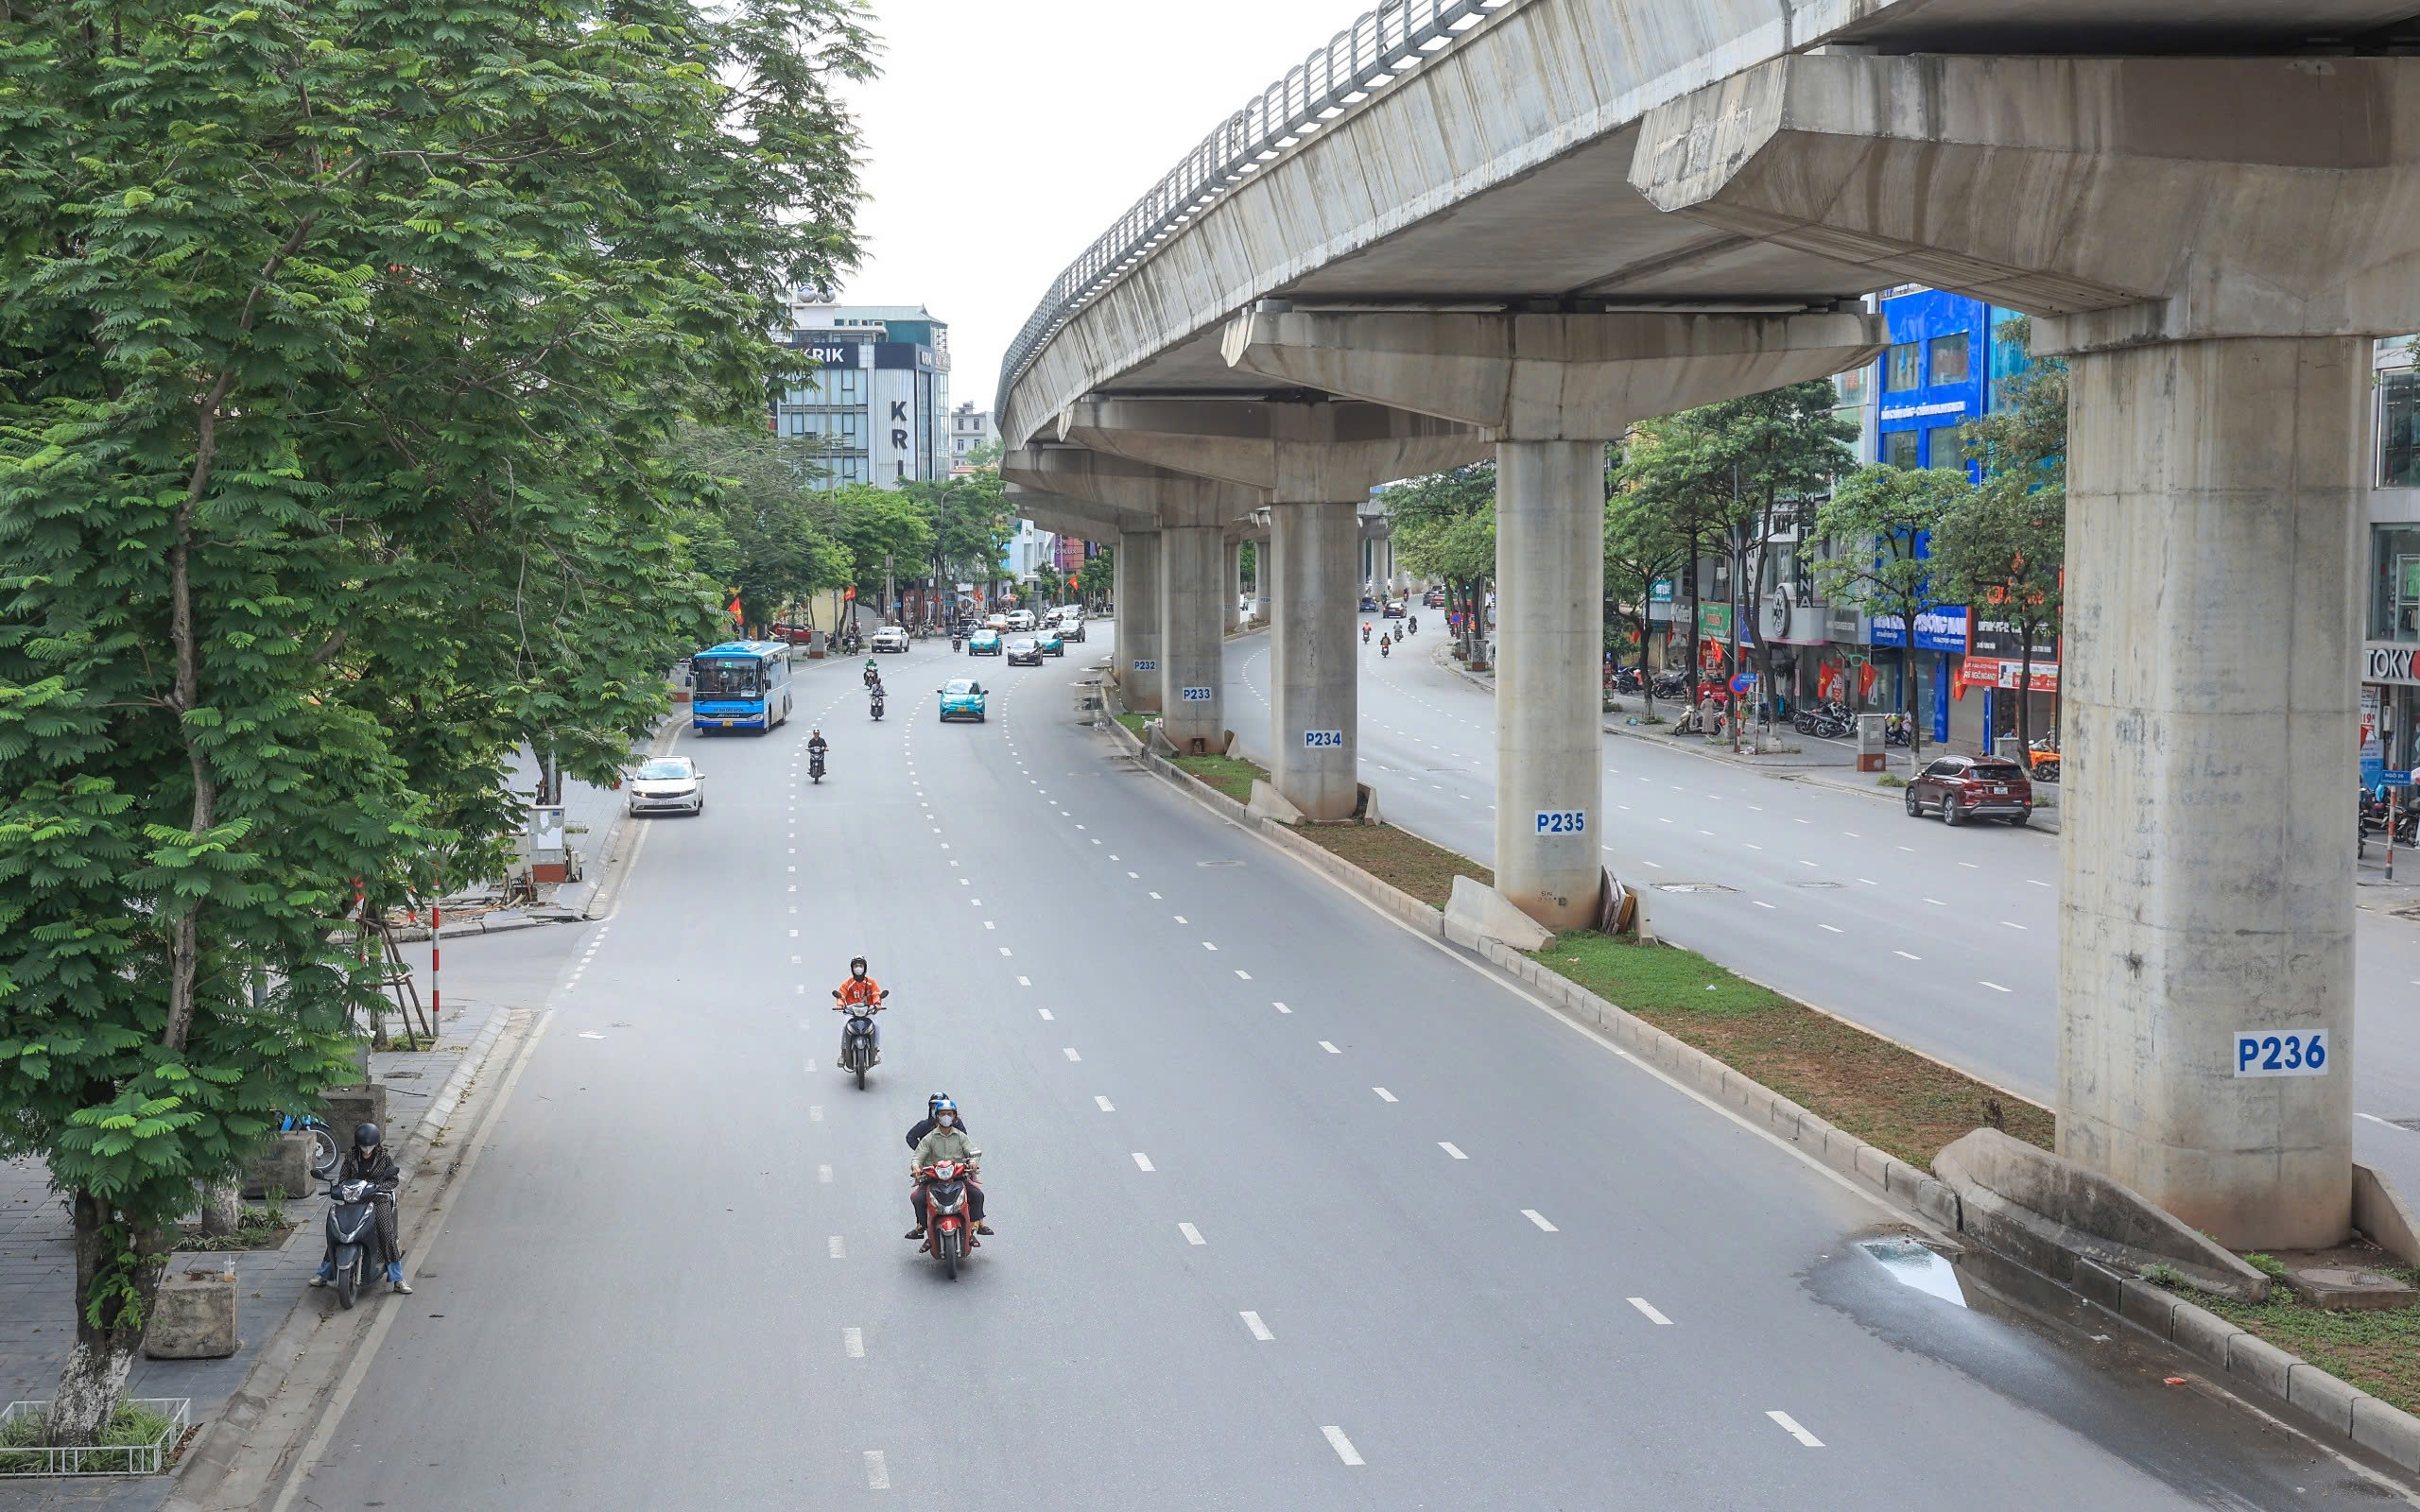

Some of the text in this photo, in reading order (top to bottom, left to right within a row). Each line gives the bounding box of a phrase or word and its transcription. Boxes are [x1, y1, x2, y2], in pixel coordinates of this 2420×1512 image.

[1184, 689, 1210, 699] P233
[1305, 731, 1340, 746] P234
[1537, 812, 1584, 833] P235
[2238, 1034, 2325, 1072] P236
